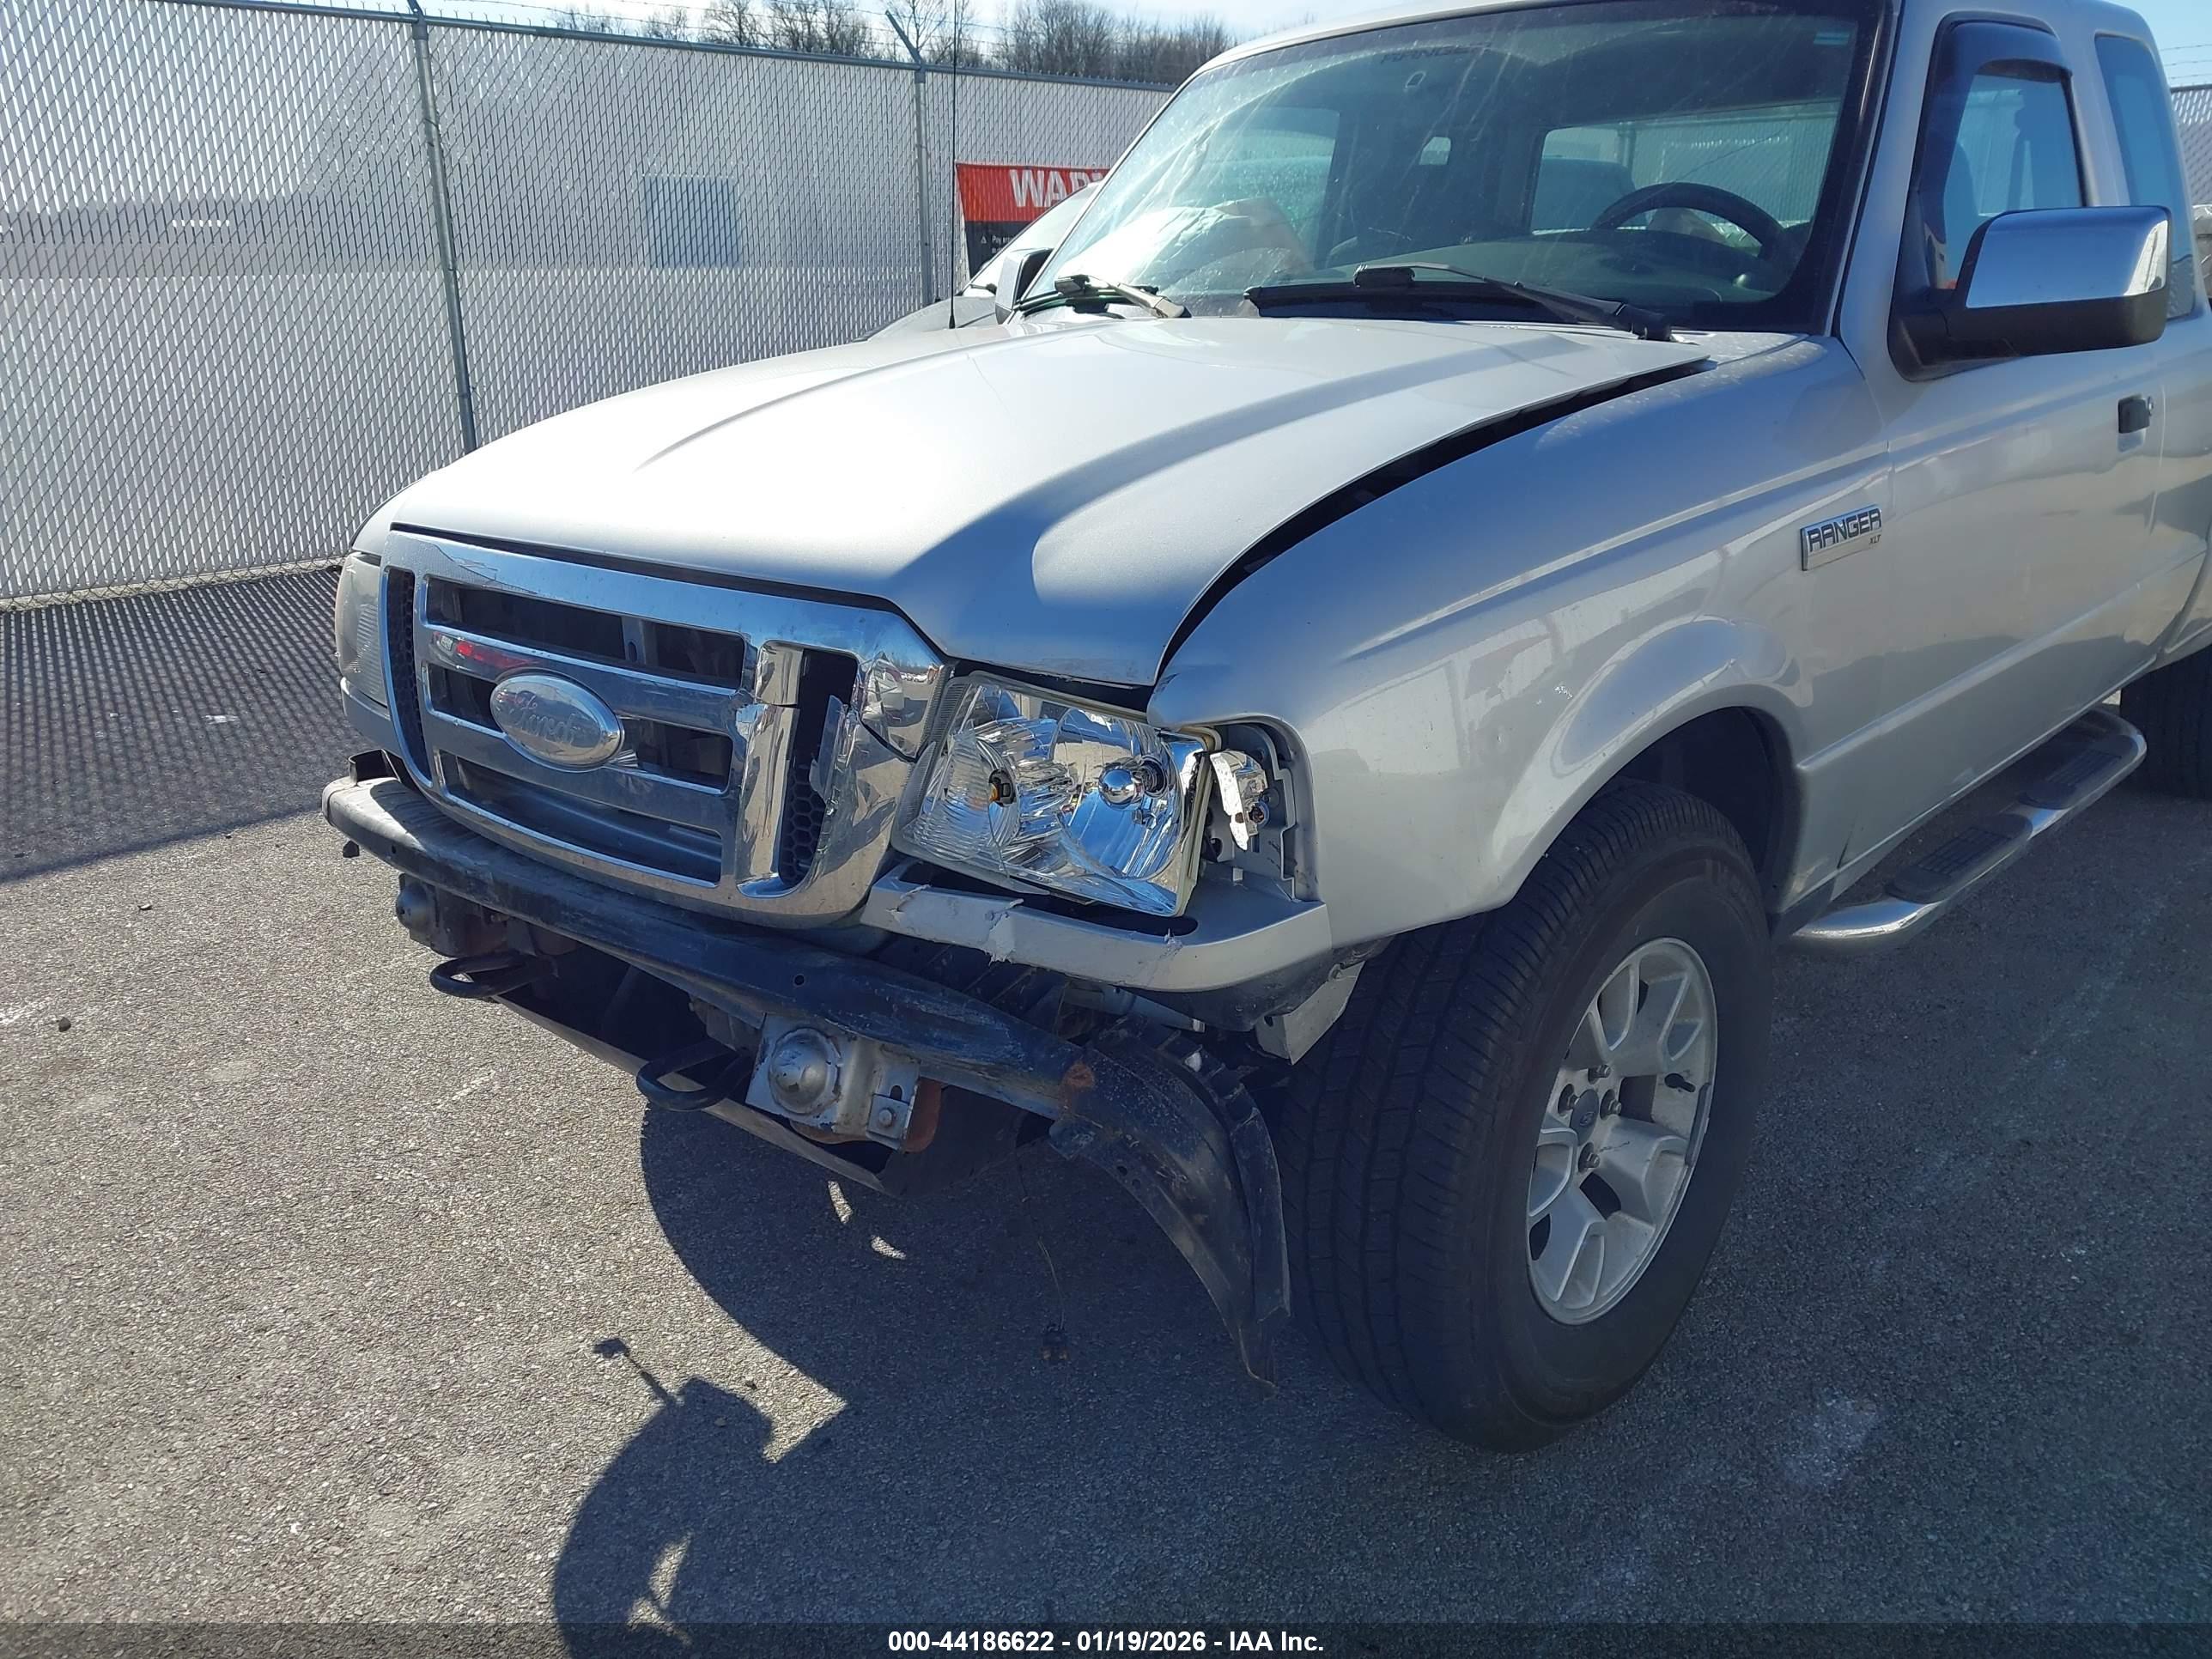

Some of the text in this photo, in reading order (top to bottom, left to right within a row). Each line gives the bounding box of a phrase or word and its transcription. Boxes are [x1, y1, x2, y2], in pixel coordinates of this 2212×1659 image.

[1009, 168, 1103, 208] WAR
[1807, 507, 1882, 553] RANGER
[1869, 534, 1881, 544] XLT
[513, 690, 581, 747] Ford
